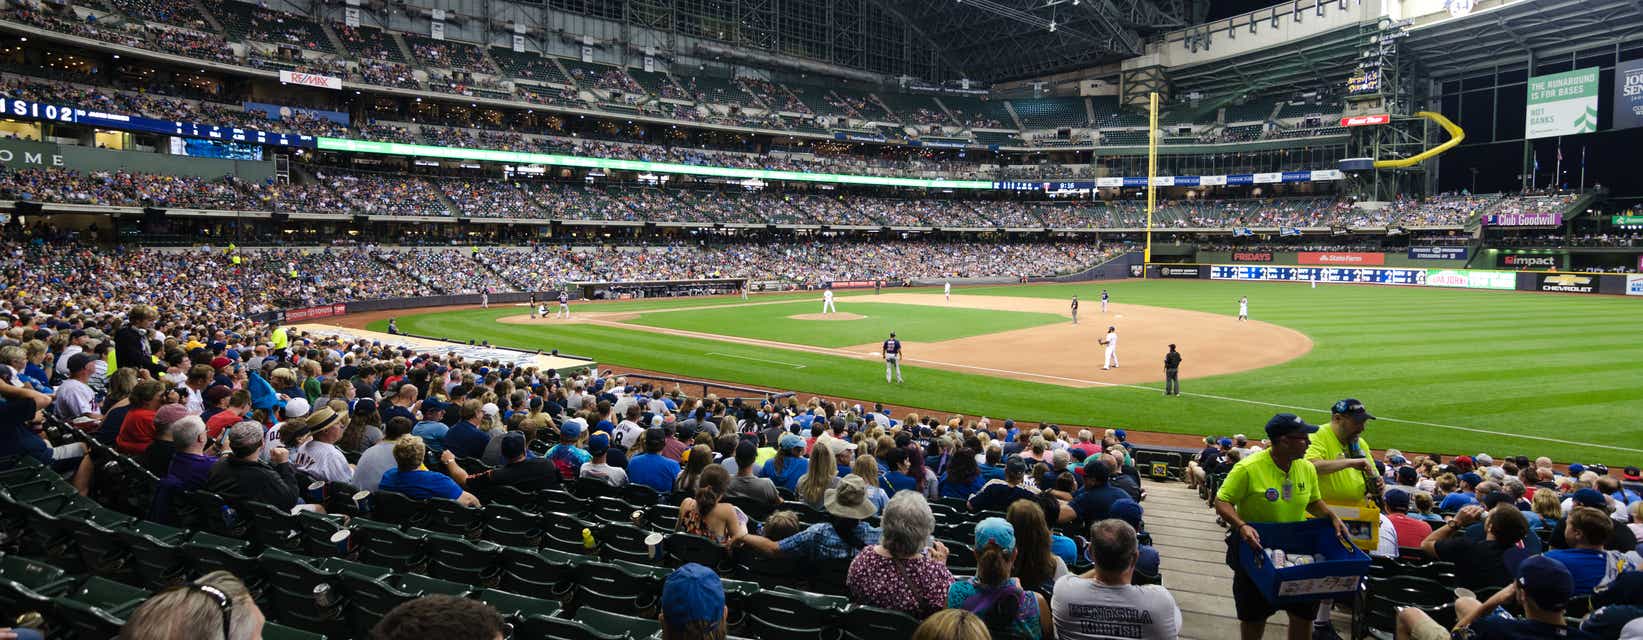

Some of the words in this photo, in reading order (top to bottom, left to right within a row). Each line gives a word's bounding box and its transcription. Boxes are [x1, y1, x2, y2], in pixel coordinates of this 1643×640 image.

[290, 72, 329, 87] RE/MAX
[1531, 82, 1545, 91] THE
[1548, 73, 1595, 88] RUNAROUND
[1531, 91, 1540, 100] IS
[1541, 89, 1555, 99] FOR
[1558, 85, 1584, 96] BASES
[1499, 214, 1516, 226] Club
[1519, 212, 1556, 226] Goodwill
[1513, 256, 1554, 266] impact
